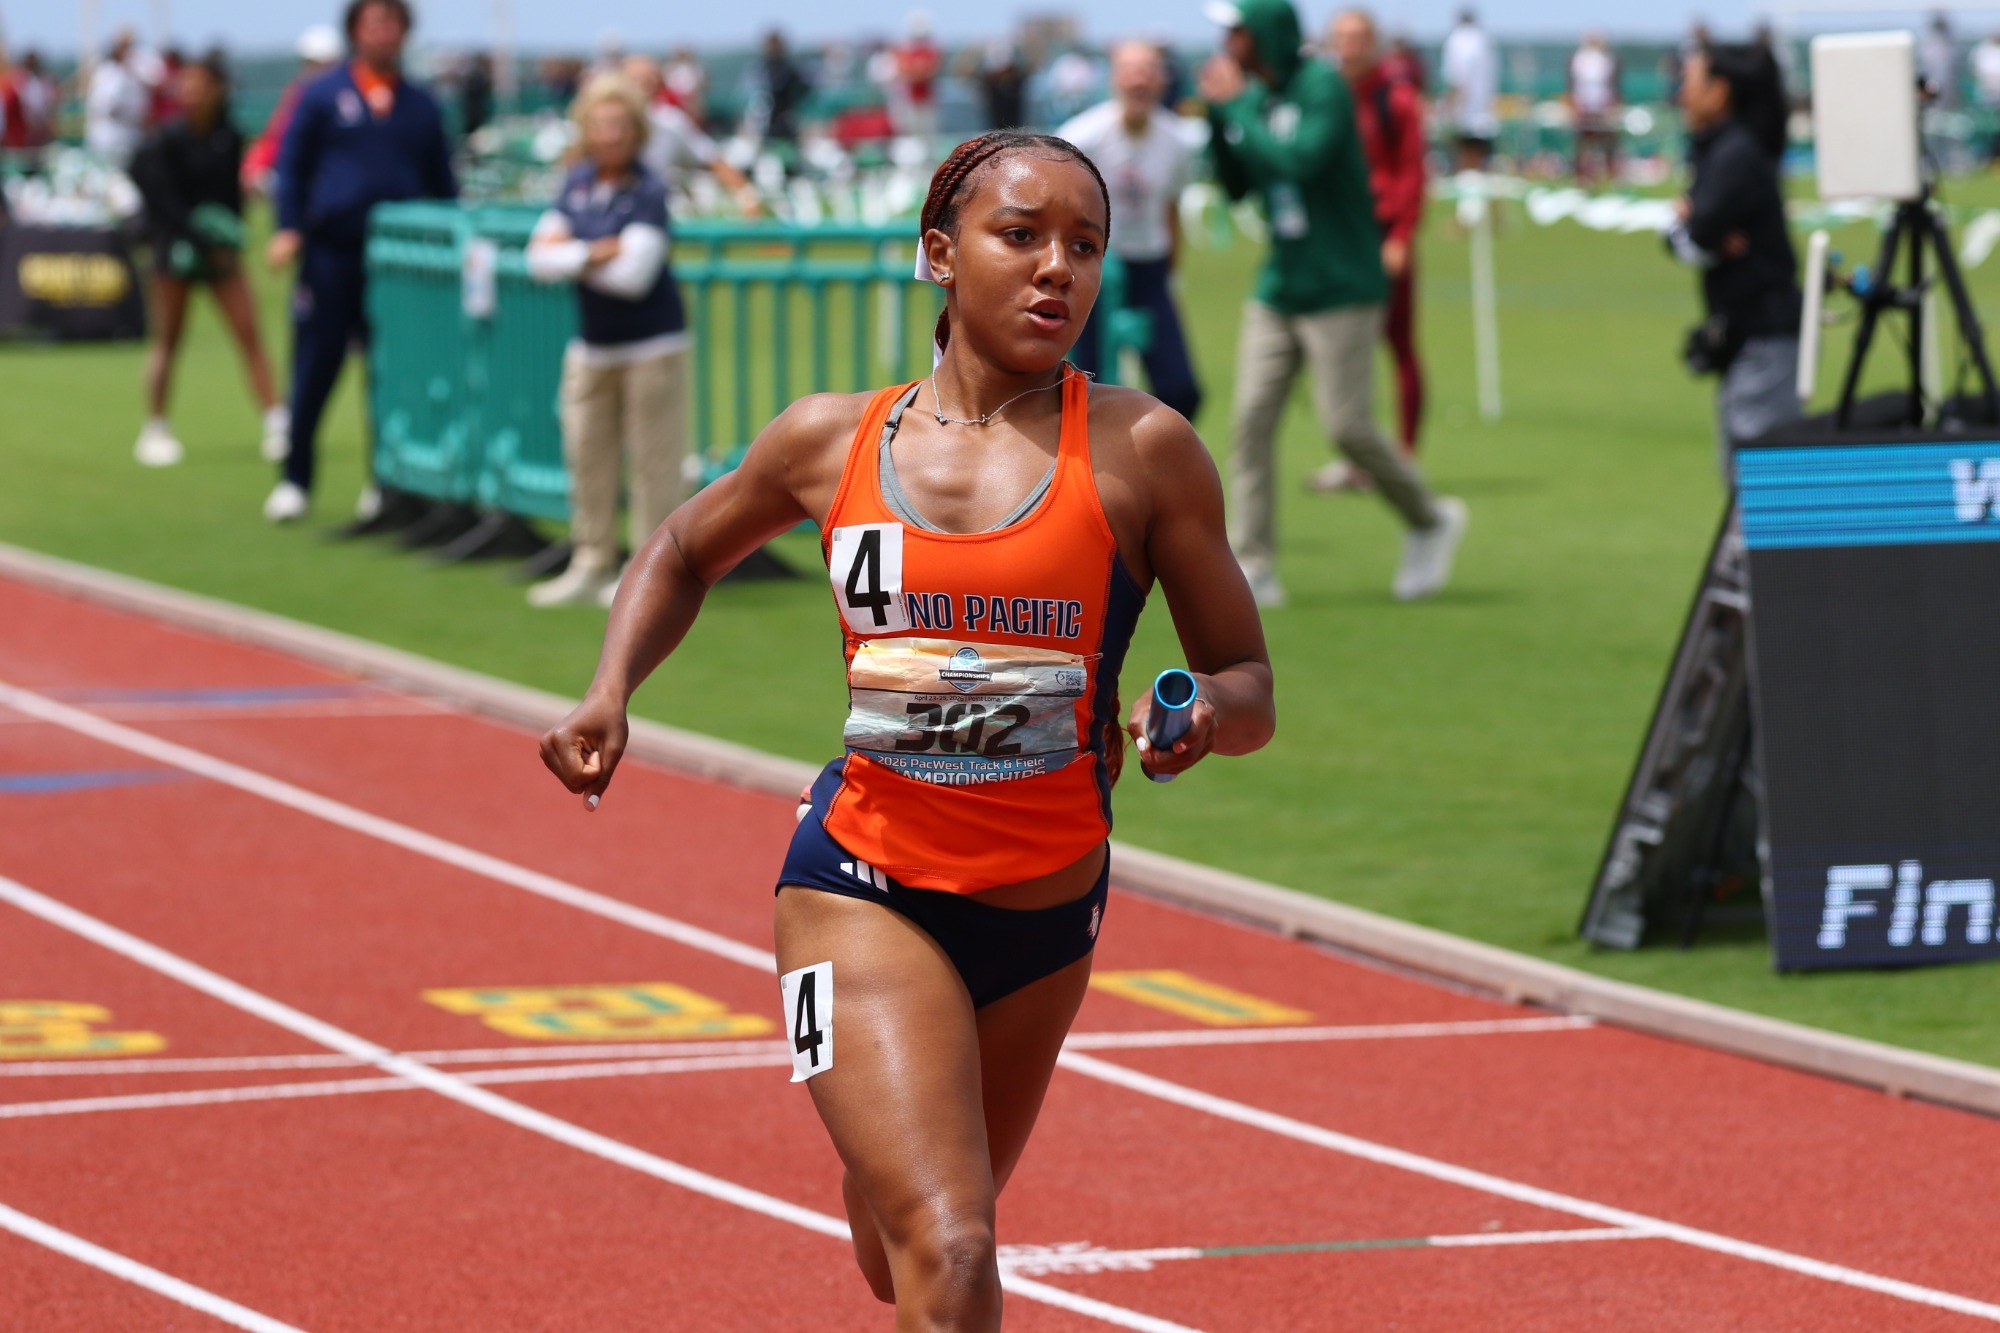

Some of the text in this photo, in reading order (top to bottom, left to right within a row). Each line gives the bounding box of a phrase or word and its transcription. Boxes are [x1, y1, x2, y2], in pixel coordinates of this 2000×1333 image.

[845, 529, 892, 627] 4
[902, 592, 954, 631] NO
[963, 594, 1083, 639] PACIFIC
[941, 671, 991, 680] CHAMPIONSHIPS
[895, 703, 1031, 756] 302
[877, 755, 1046, 771] 2026 PacWest Track & Field
[896, 766, 1047, 786] AMPIONSHIPS
[1817, 859, 2000, 949] Fin
[795, 971, 824, 1068] 4
